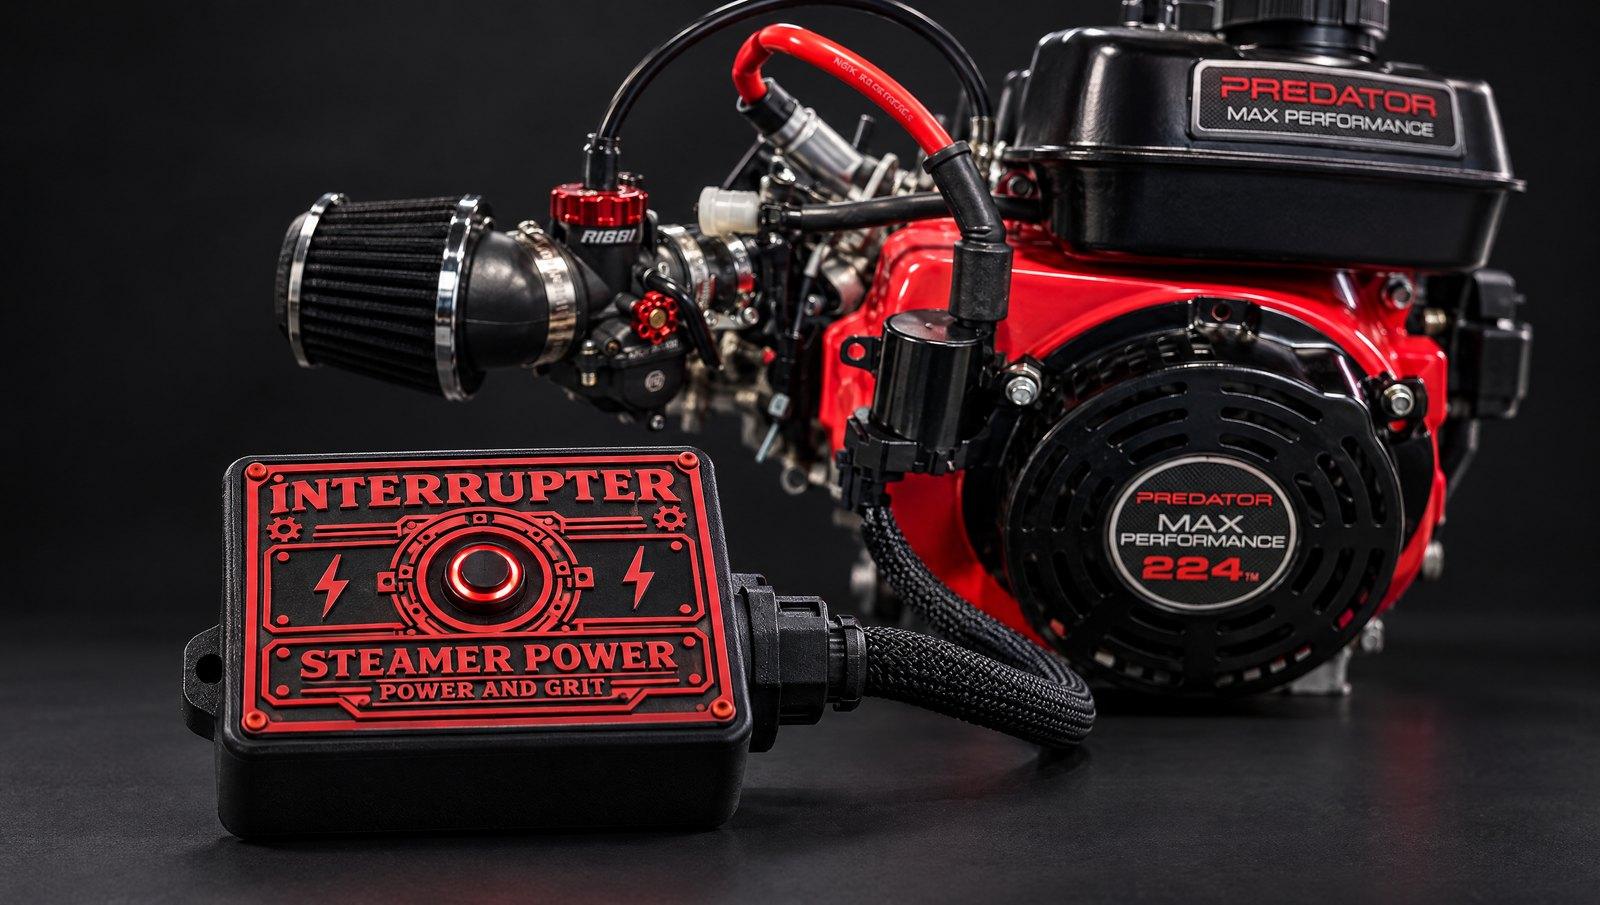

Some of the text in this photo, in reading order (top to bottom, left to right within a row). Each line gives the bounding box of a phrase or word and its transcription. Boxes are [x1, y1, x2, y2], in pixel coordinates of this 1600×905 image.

[1220, 76, 1437, 118] PREDATOR
[1227, 106, 1434, 137] MAX PERFORMANCE
[1136, 491, 1273, 506] PREDATOR
[1158, 513, 1244, 533] MAX
[1120, 532, 1286, 548] PERFORMANCE
[301, 640, 679, 678] STEAMER POWER
[379, 677, 605, 702] POWER AND GRIT
